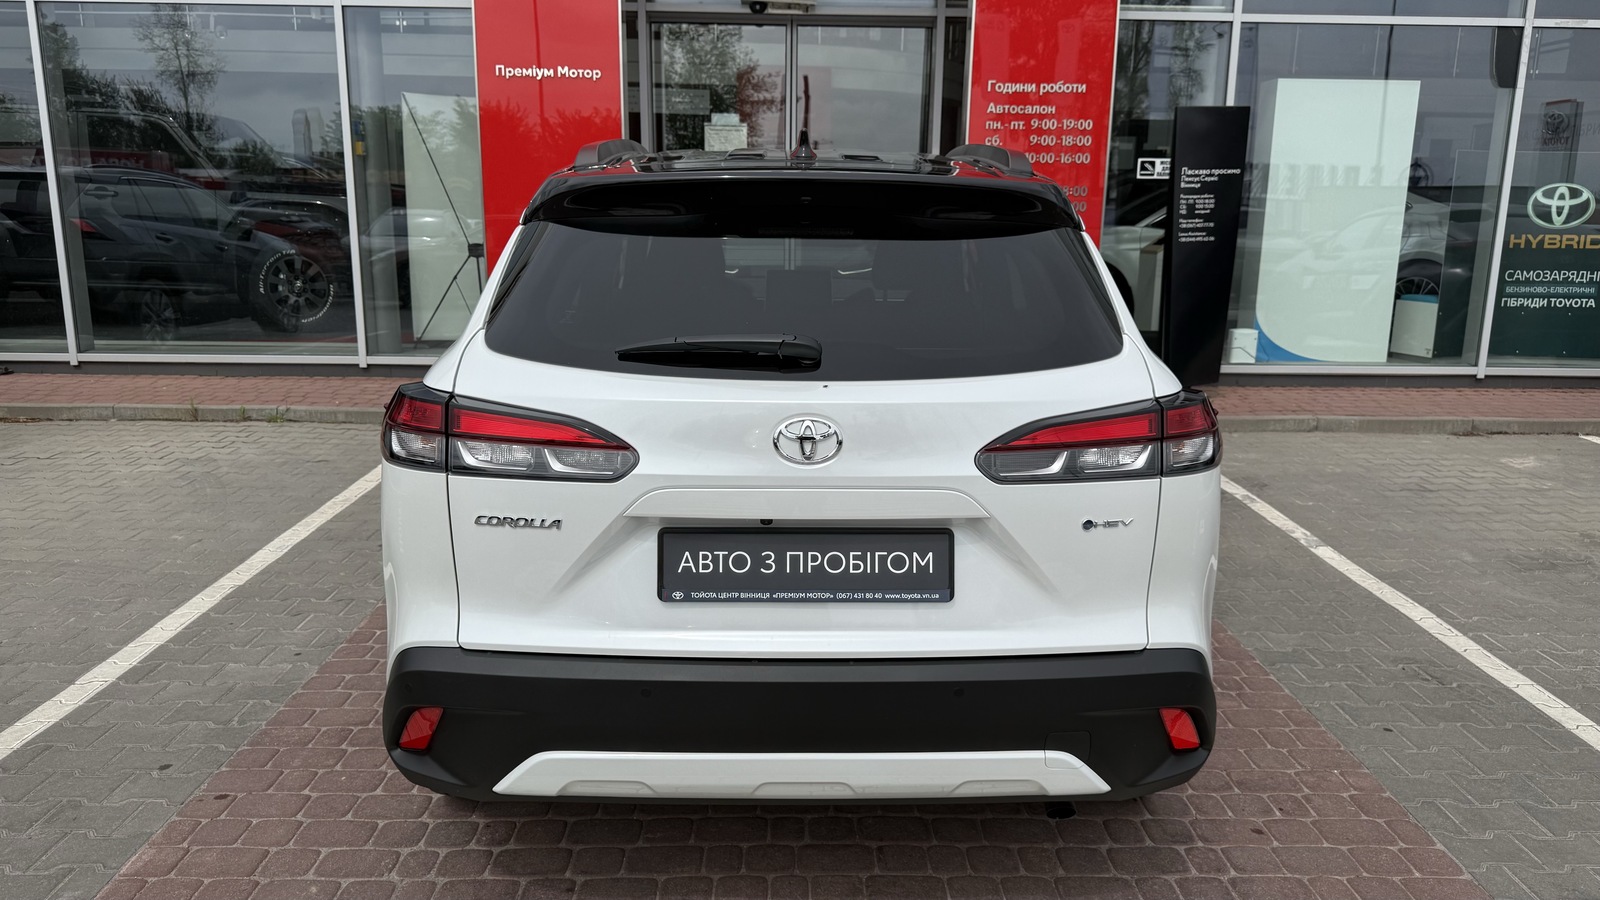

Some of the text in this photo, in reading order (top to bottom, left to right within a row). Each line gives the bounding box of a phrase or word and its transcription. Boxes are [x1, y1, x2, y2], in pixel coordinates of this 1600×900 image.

[495, 65, 601, 81] Преміум Мотор
[987, 80, 1087, 95] Години роботи
[987, 102, 1056, 114] Автосалон
[1031, 119, 1093, 130] 9:00-19:00
[985, 135, 1092, 146] сб. 9:00-18:00
[1181, 167, 1241, 176] Ласкаво просимо
[1505, 286, 1595, 294] БЕНЗИНОВО-ЕЛЕКТРИЧНІ
[1501, 297, 1596, 308] ГІБРИДИ TOYOTA
[474, 515, 563, 530] COROLLA
[678, 551, 933, 574] АВТО З ПРОБІГОМ
[691, 591, 717, 599] ТОЙОТА
[884, 592, 940, 600] www.toyota.vn.ua
